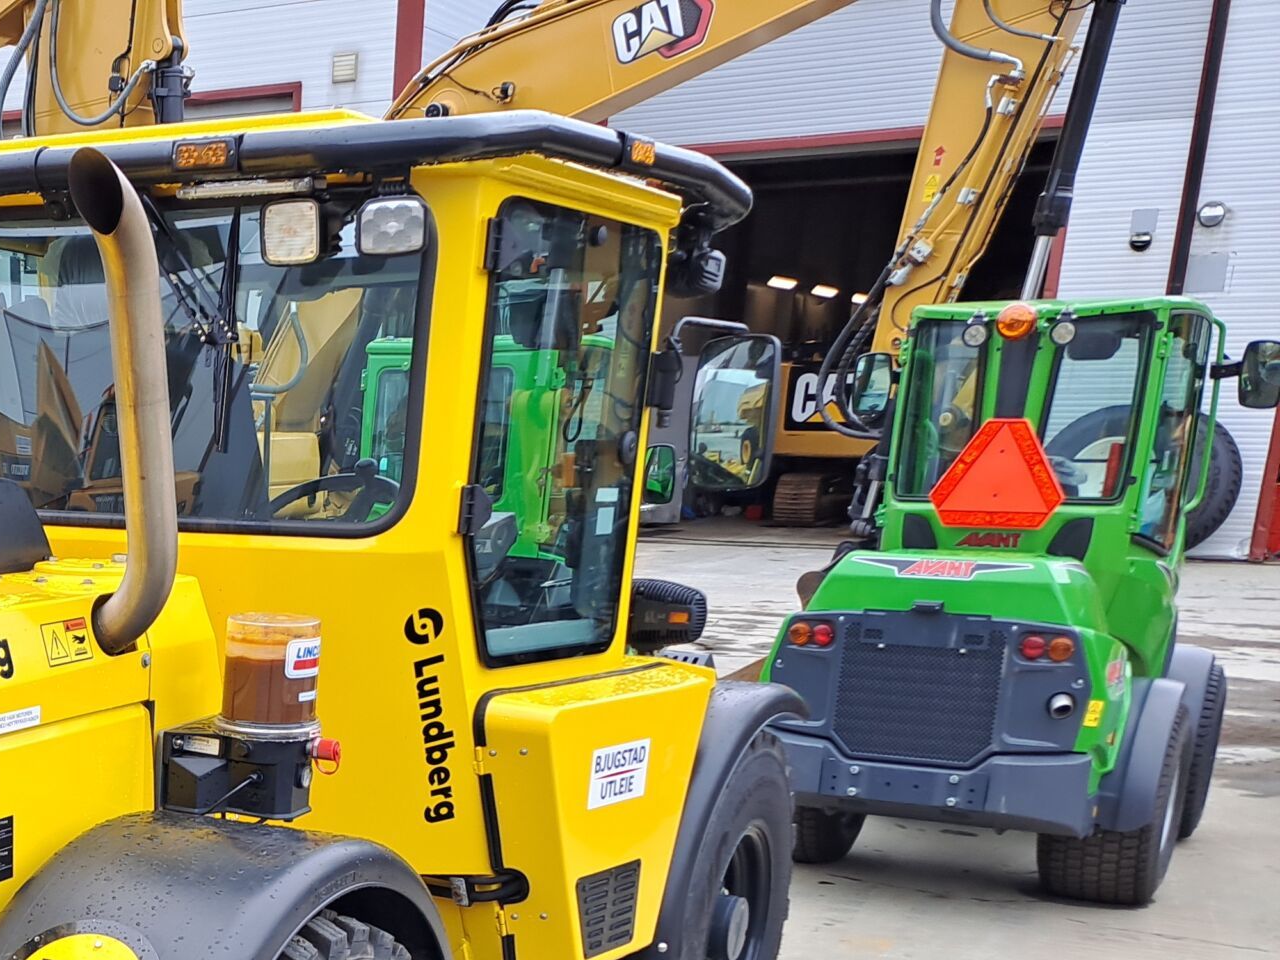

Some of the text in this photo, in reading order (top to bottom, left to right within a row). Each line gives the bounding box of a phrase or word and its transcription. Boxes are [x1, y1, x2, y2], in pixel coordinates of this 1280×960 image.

[612, 0, 685, 64] CAT
[791, 372, 855, 423] CA
[954, 531, 1023, 549] AVANT
[900, 559, 977, 577] AVANT
[414, 653, 456, 824] Lundberg
[595, 745, 646, 774] BJUGSTAD
[600, 775, 635, 800] UTLEIE
